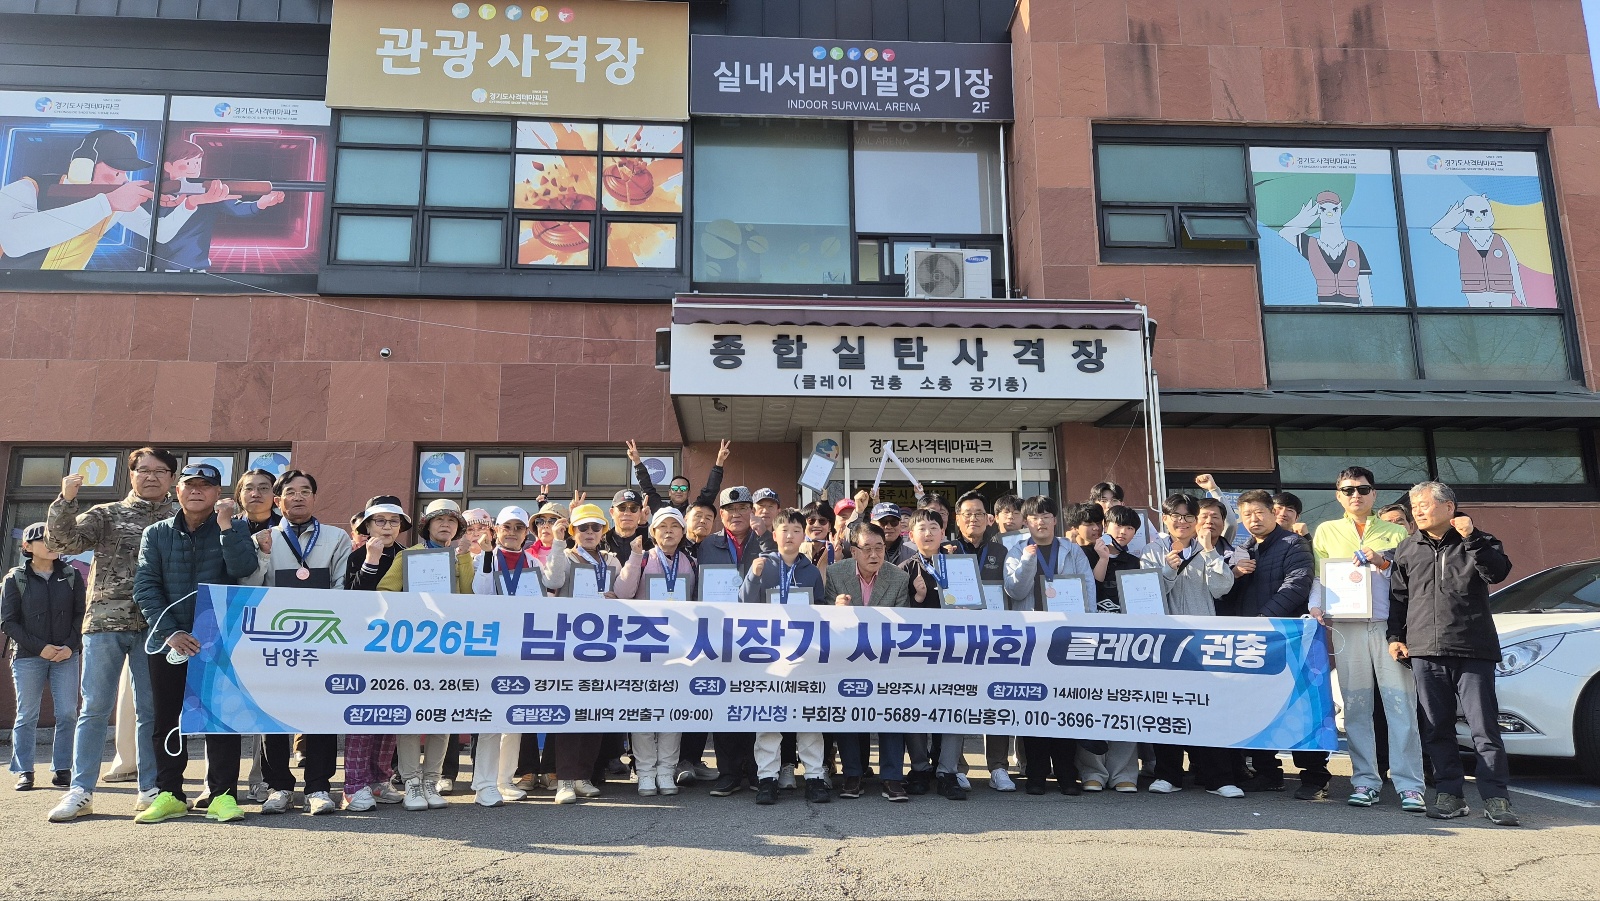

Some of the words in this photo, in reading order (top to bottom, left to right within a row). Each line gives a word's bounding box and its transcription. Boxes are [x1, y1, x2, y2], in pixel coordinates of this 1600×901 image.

[376, 28, 644, 86] 관광사격장
[713, 62, 993, 98] 실내서바이벌경기장
[489, 92, 548, 101] 경기도사격테마파크
[55, 101, 120, 110] 경기도사격테마파크
[234, 107, 298, 116] 경기도사격테마파크
[787, 99, 828, 110] INDOOR
[831, 100, 883, 111] SURVIVAL
[884, 101, 921, 112] ARENA
[972, 101, 990, 114] 2F
[1296, 157, 1357, 165] 경기도사격테마파크
[1444, 159, 1504, 167] 경기도사격테마파크
[793, 374, 852, 391] (클레이
[870, 375, 902, 391] 권총
[919, 376, 953, 391] 소총
[969, 377, 1028, 393] 공기총)
[869, 438, 994, 454] 경기도사격테마파크
[364, 619, 500, 657] 2026년
[520, 612, 670, 663] 남양주
[686, 617, 830, 664] 시장기
[846, 621, 1036, 667] 사격대회
[1066, 632, 1164, 664] 클레이
[1173, 635, 1188, 663] /
[1200, 634, 1268, 670] 권총
[262, 647, 320, 667] 남양주
[330, 678, 360, 692] 일시
[370, 679, 409, 691] 2026.
[413, 679, 435, 691] 03.
[439, 678, 480, 692] 28(토)
[496, 679, 526, 693] 장소
[534, 679, 573, 692] 경기도
[578, 679, 679, 693] 종합사격장(화성)
[694, 680, 722, 693] 주최
[730, 679, 826, 694] 남양주시(체육회)
[842, 681, 869, 694] 주관
[876, 682, 926, 695] 남양주시
[929, 683, 978, 697] 사격연맹
[993, 683, 1043, 698] 참가자격
[1052, 687, 1104, 700] 14세이상
[1107, 689, 1168, 704] 남양주시민
[1172, 692, 1210, 707] 누구나
[349, 708, 407, 723] 참가인원
[416, 708, 447, 722] 60명
[451, 708, 493, 722] 선착순
[511, 708, 567, 723] 출발장소
[574, 708, 614, 722] 별내역
[619, 708, 665, 722] 2번출구
[669, 708, 714, 722] (09:00)
[727, 705, 788, 722] 참가신청
[802, 706, 847, 723] 부회장
[851, 706, 1020, 727] 010-5689-4716(남홍우),
[1024, 710, 1192, 736] 010-3696-7251(우영준)
